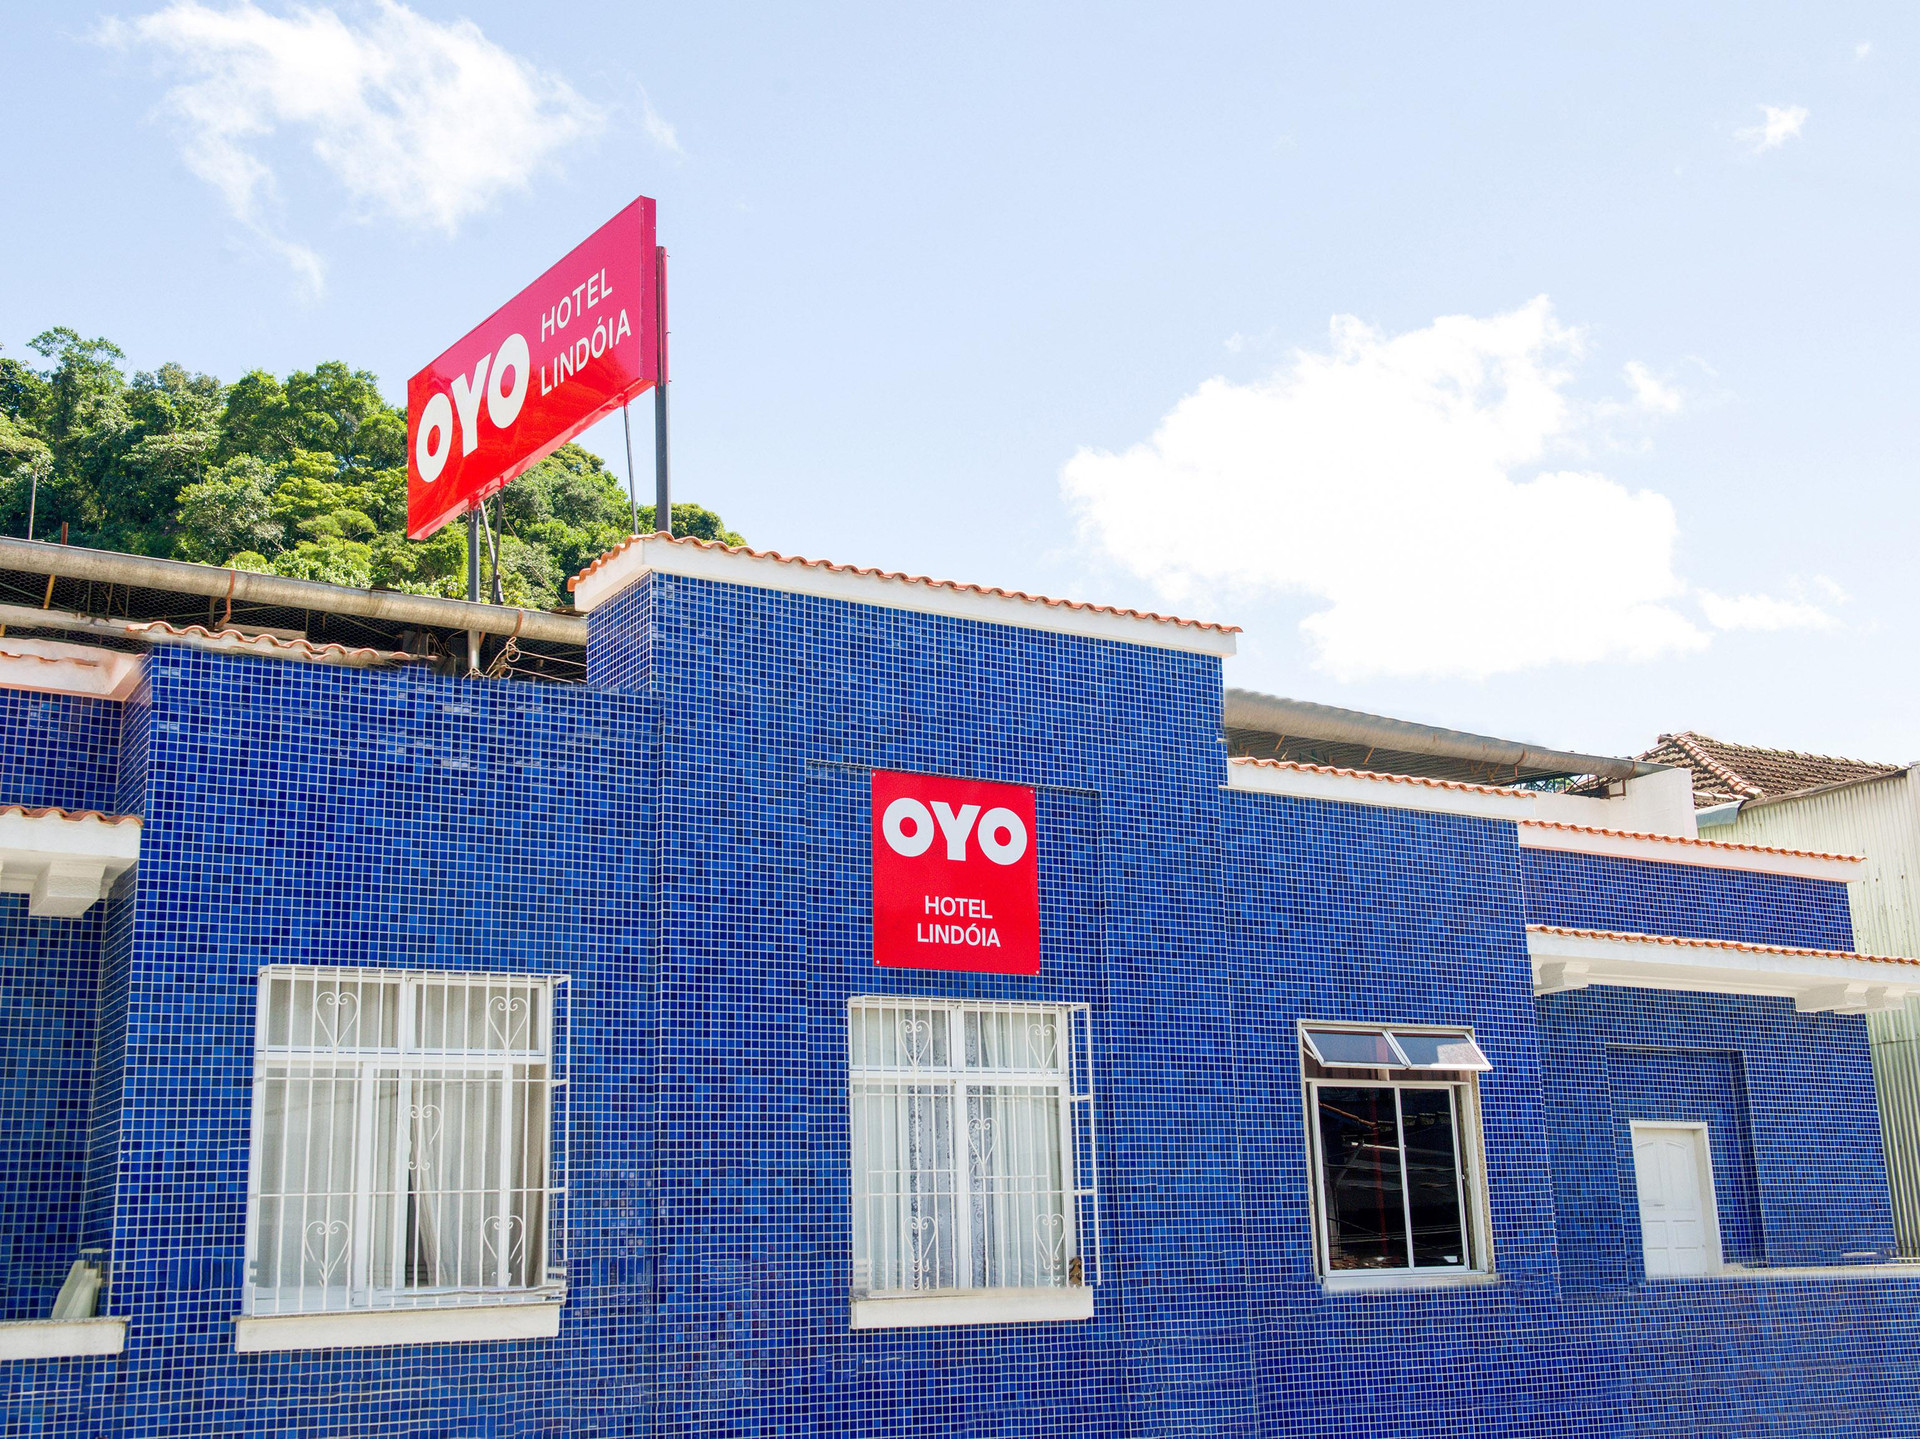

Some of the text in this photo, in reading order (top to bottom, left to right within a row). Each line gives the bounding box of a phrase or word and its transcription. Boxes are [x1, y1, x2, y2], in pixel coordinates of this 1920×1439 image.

[541, 268, 613, 343] HOTEL
[541, 308, 632, 397] LINDÓIA
[416, 333, 530, 483] OYO
[882, 797, 1028, 866] OYO
[917, 922, 1001, 947] LINDÓIA
[924, 895, 993, 919] HOTEL
